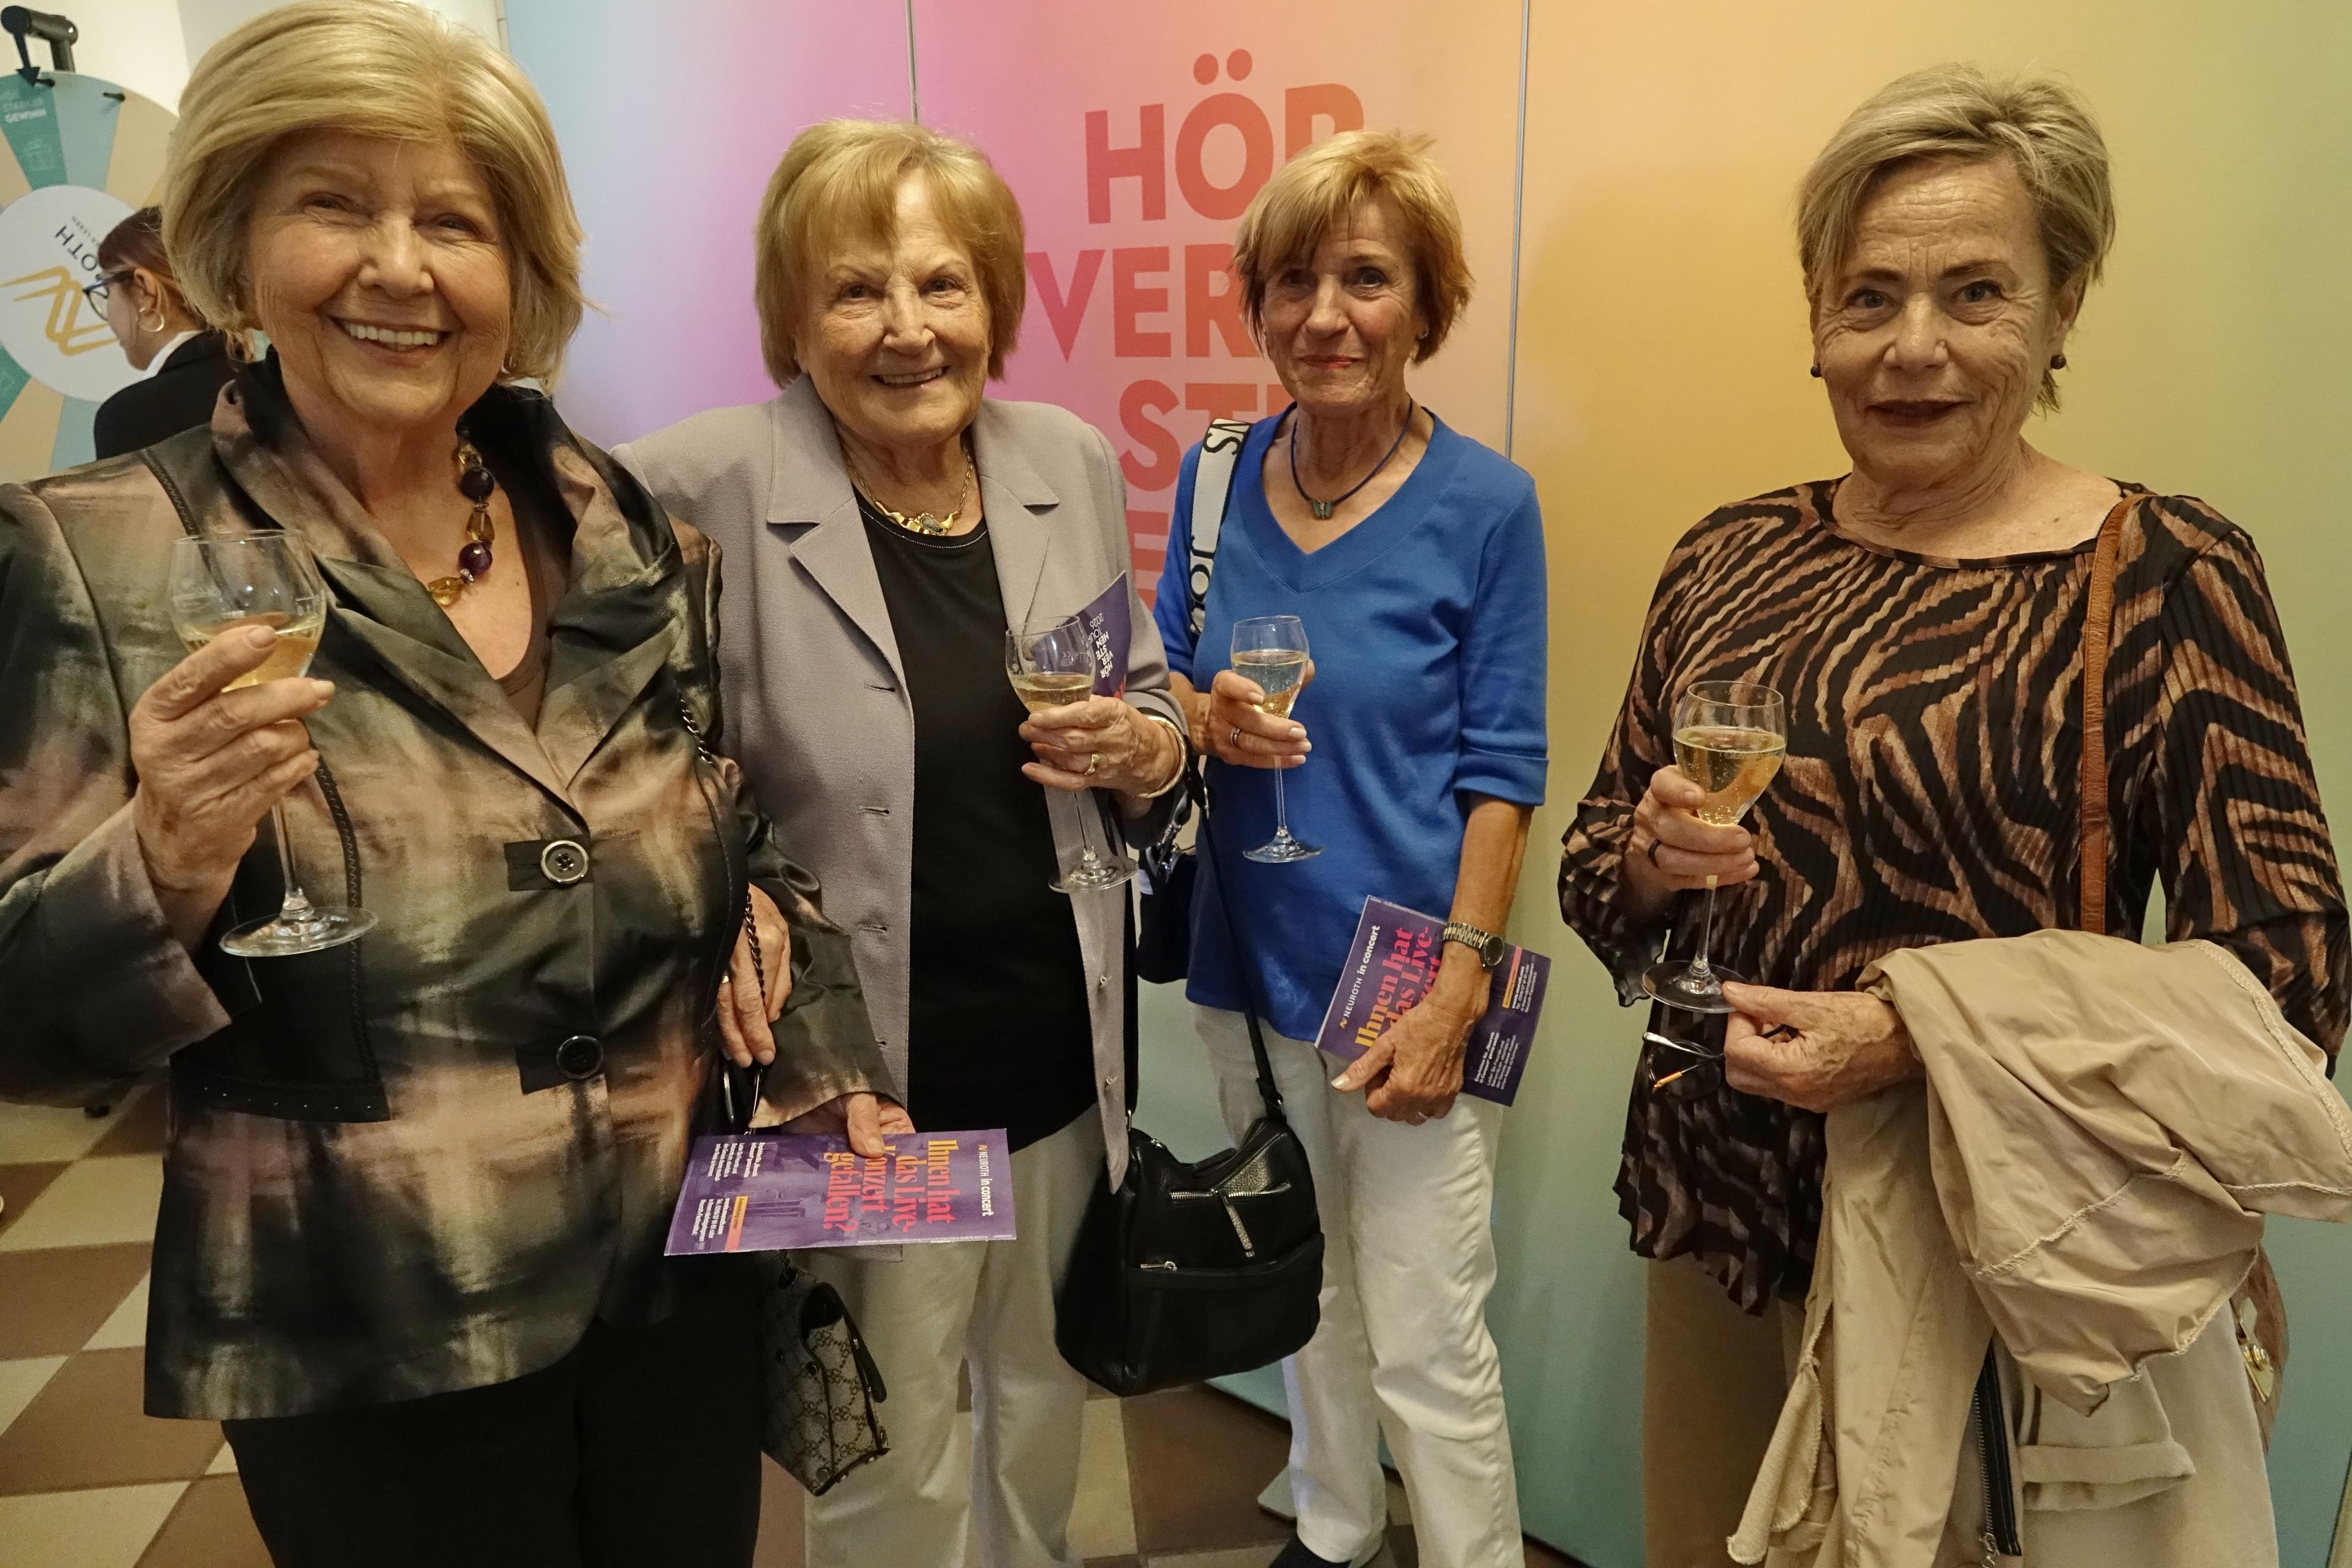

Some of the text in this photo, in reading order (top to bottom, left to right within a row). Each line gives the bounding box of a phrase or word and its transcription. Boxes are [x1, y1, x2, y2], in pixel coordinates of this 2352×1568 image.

[55, 224, 100, 273] OTH
[1118, 380, 1295, 491] ST
[1088, 627, 1102, 644] TOUR
[1090, 612, 1104, 630] 2026
[1096, 631, 1109, 649] HEN
[1096, 644, 1107, 661] STE
[1100, 661, 1113, 678] HÖR
[1102, 650, 1114, 666] VER
[1343, 925, 1380, 1018] NEUROTH in concert
[1401, 927, 1432, 983] Live-
[1355, 975, 1399, 1047] Ihnen
[1382, 927, 1414, 971] hat
[927, 1139, 960, 1224] Ihnen hat
[979, 1152, 989, 1177] NEUROTH
[823, 1152, 862, 1231] gefallen?
[892, 1155, 927, 1233] das Live-
[981, 1186, 993, 1216] concert
